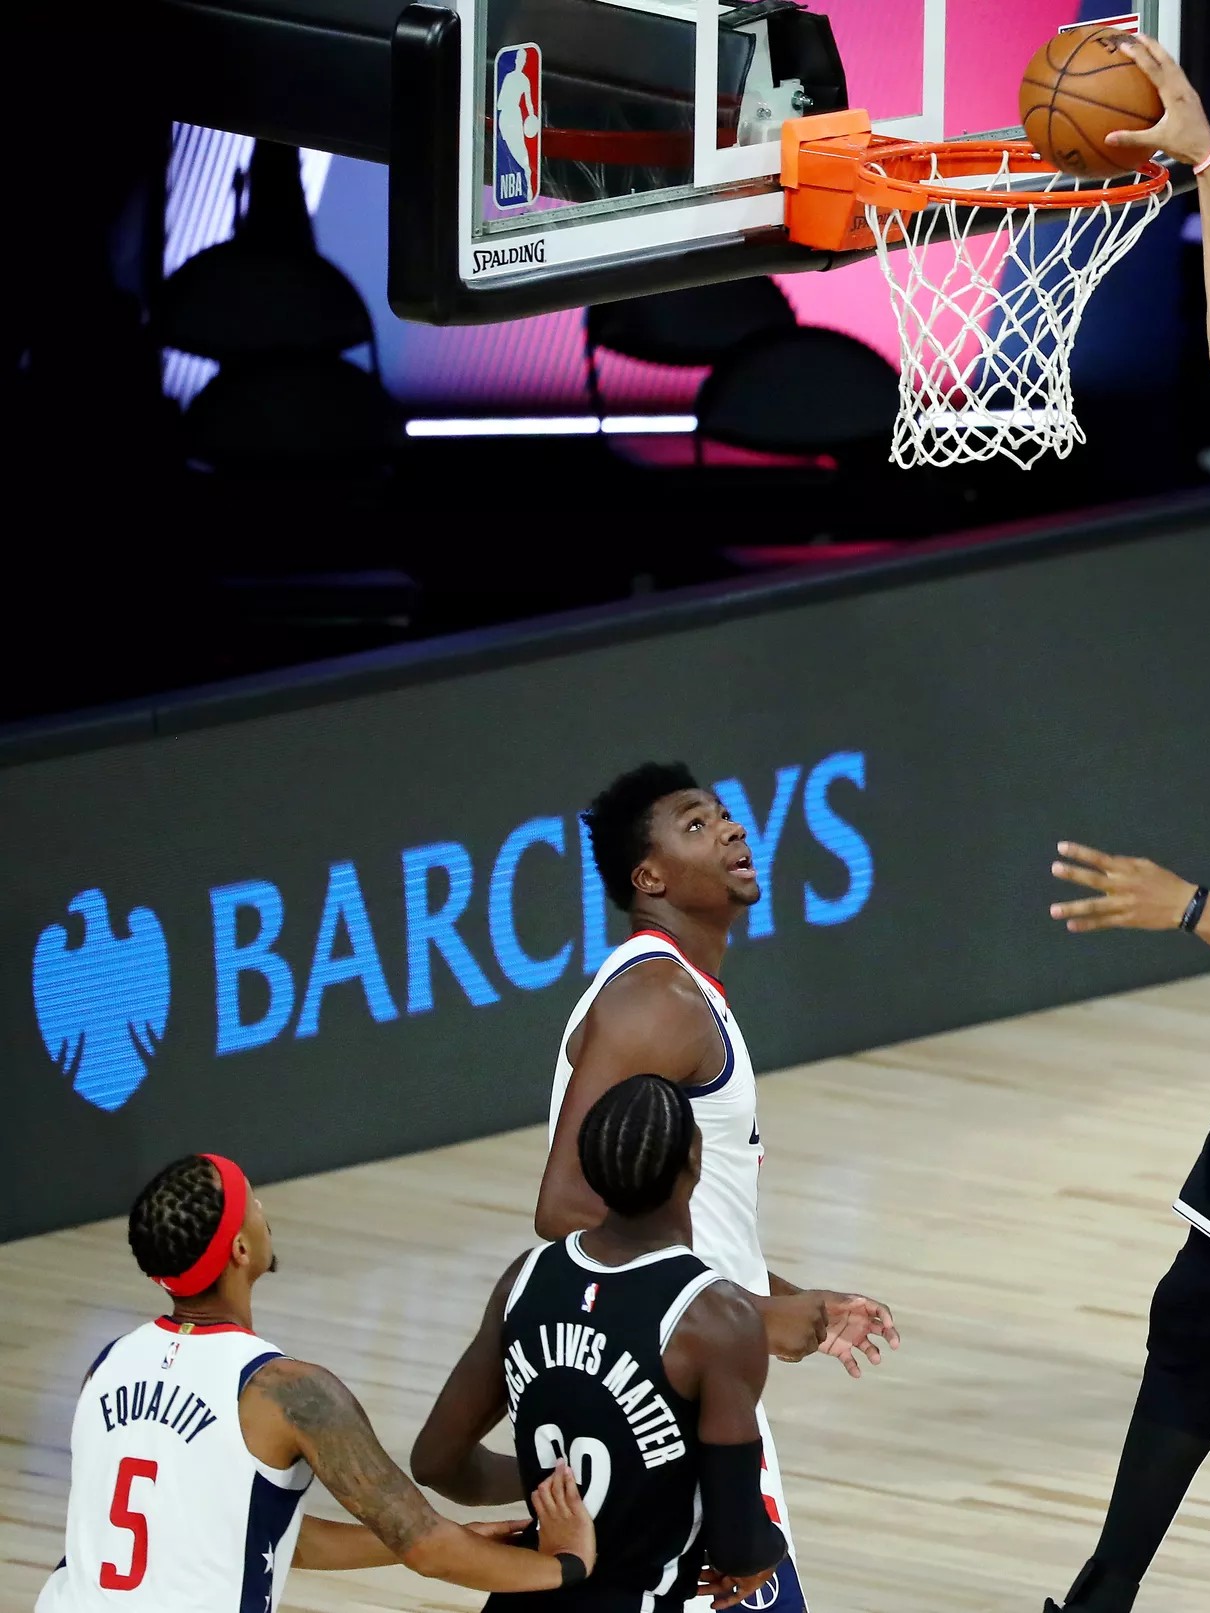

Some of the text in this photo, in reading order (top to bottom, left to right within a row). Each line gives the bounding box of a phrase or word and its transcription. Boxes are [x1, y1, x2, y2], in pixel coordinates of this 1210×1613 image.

[500, 172, 522, 199] NBA
[473, 239, 545, 274] SPALDING
[210, 751, 874, 1056] BARCLYS
[100, 1380, 217, 1444] EQUALITY
[539, 1322, 607, 1376] LIVES
[601, 1350, 686, 1470] MATTER
[99, 1456, 158, 1591] 5
